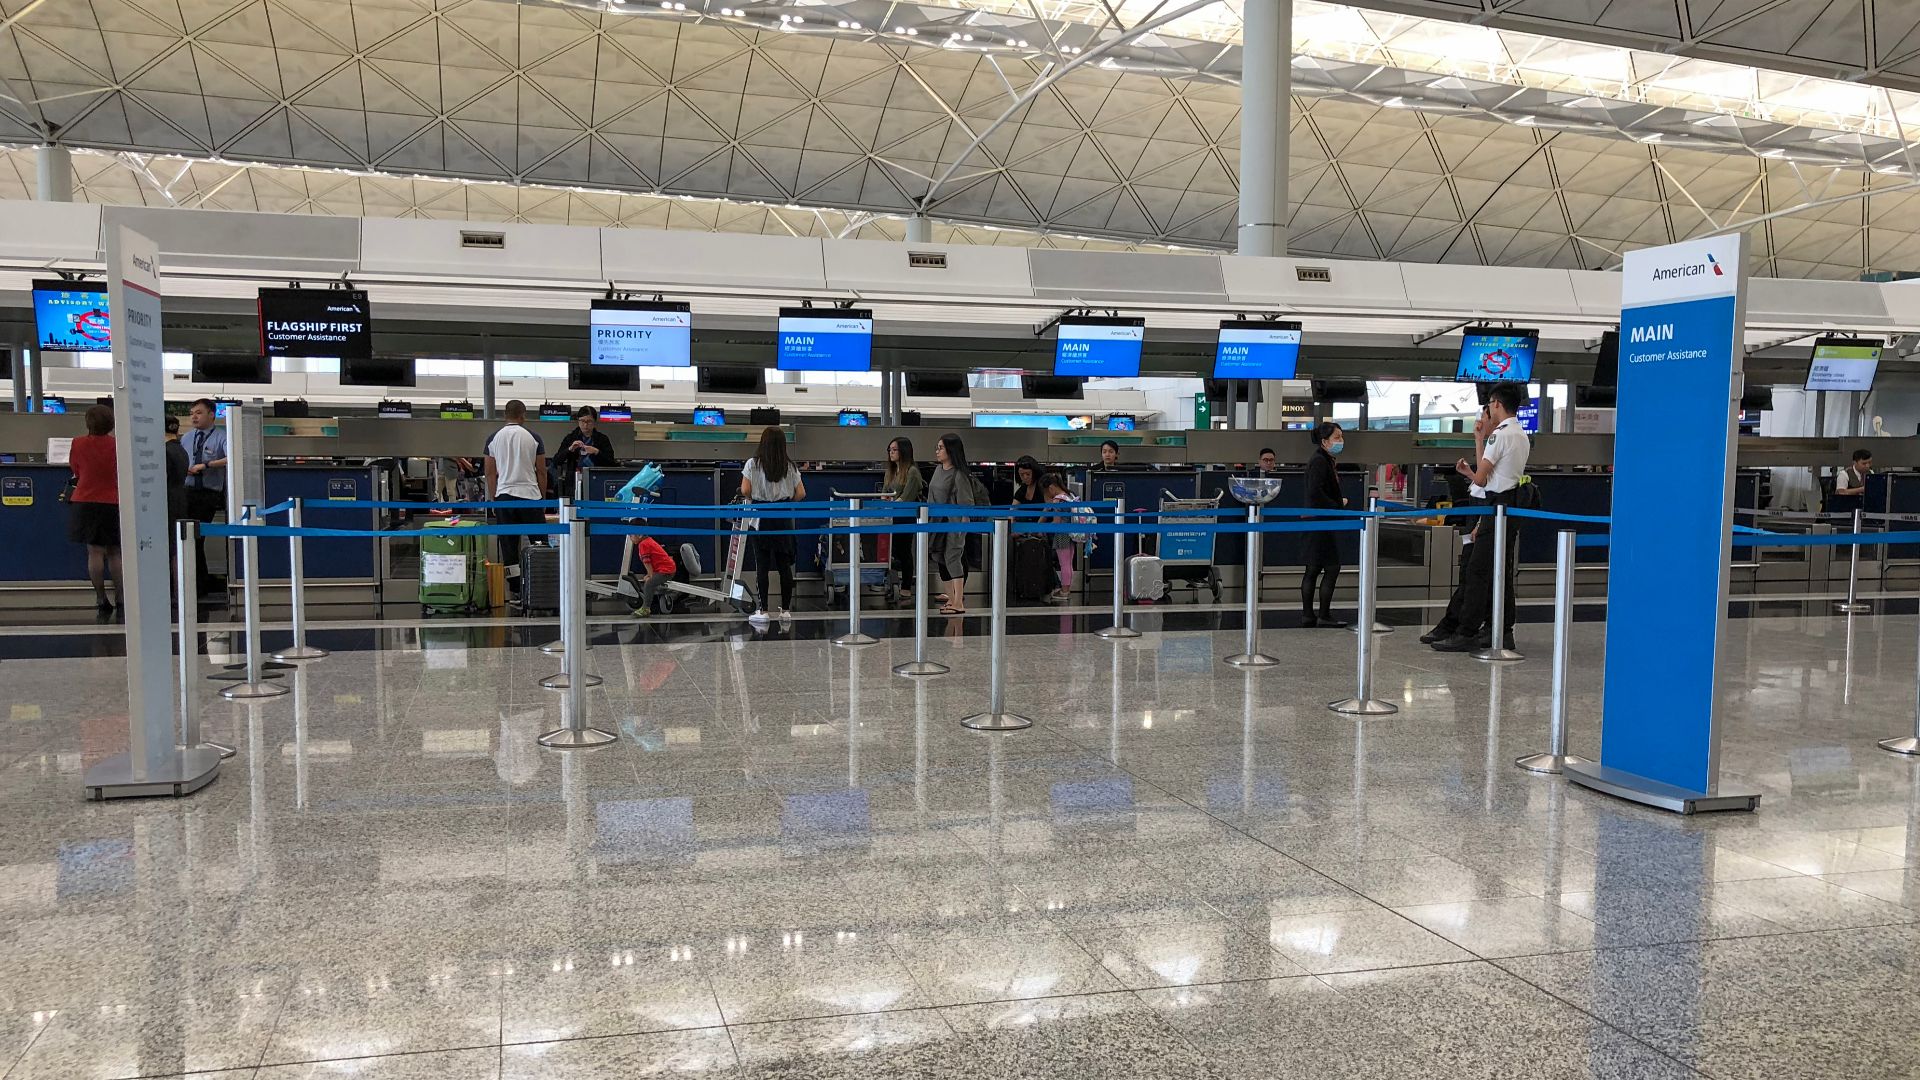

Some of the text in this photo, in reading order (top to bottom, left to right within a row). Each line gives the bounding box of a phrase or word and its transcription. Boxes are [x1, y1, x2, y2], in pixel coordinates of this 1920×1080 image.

[133, 254, 151, 272] American
[1653, 264, 1705, 281] American
[128, 308, 151, 328] PRIORITY
[267, 321, 362, 332] FLAGSHIP FIRST
[598, 330, 652, 339] PRIORITY
[1630, 324, 1674, 343] MAIN
[785, 336, 815, 345] MAIN
[1062, 343, 1090, 352] MAIN
[1222, 347, 1249, 355] MAIN
[1629, 349, 1707, 363] Customer Assistance
